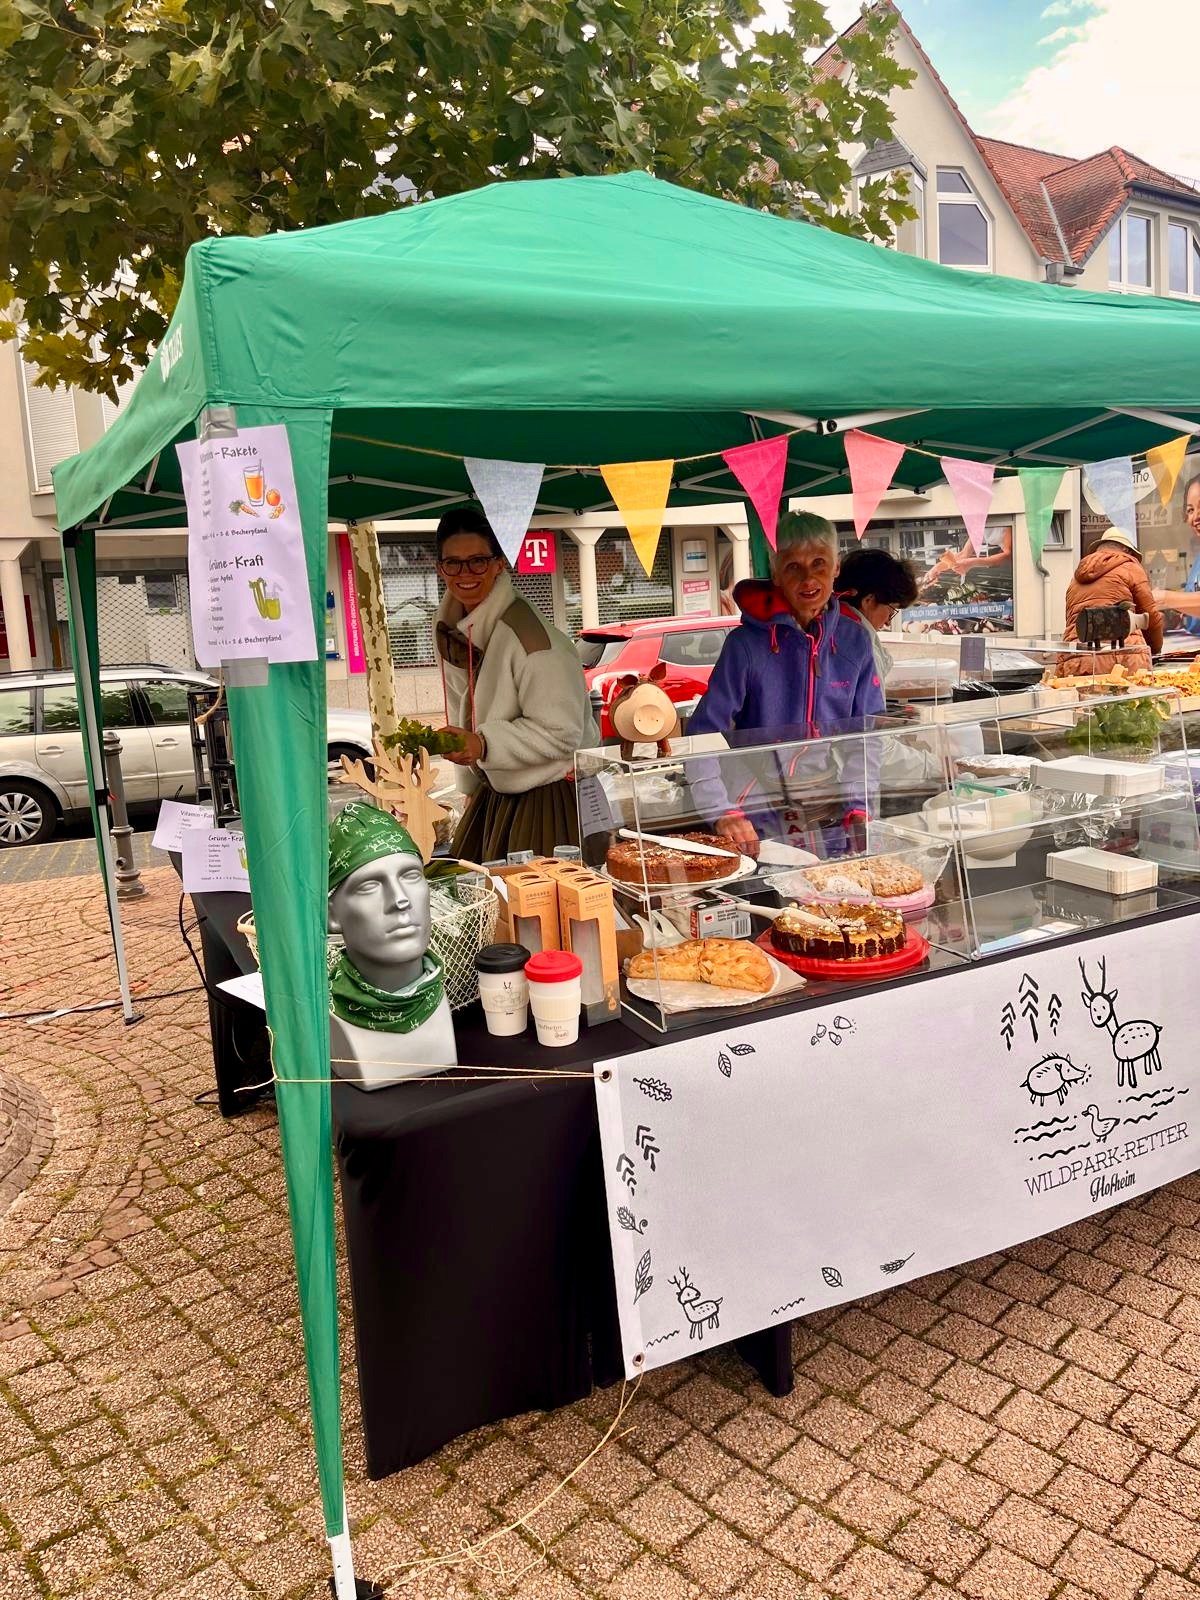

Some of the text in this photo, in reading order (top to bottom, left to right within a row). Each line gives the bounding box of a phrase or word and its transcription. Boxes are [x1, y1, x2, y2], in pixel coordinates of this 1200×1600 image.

[231, 527, 268, 536] Becherpfand
[525, 538, 548, 567] T
[244, 634, 282, 644] Becherpfand
[352, 629, 360, 657] BERATUNG
[1024, 1121, 1189, 1196] WILDPARK-RETTER
[1090, 1170, 1137, 1203] Hofheim
